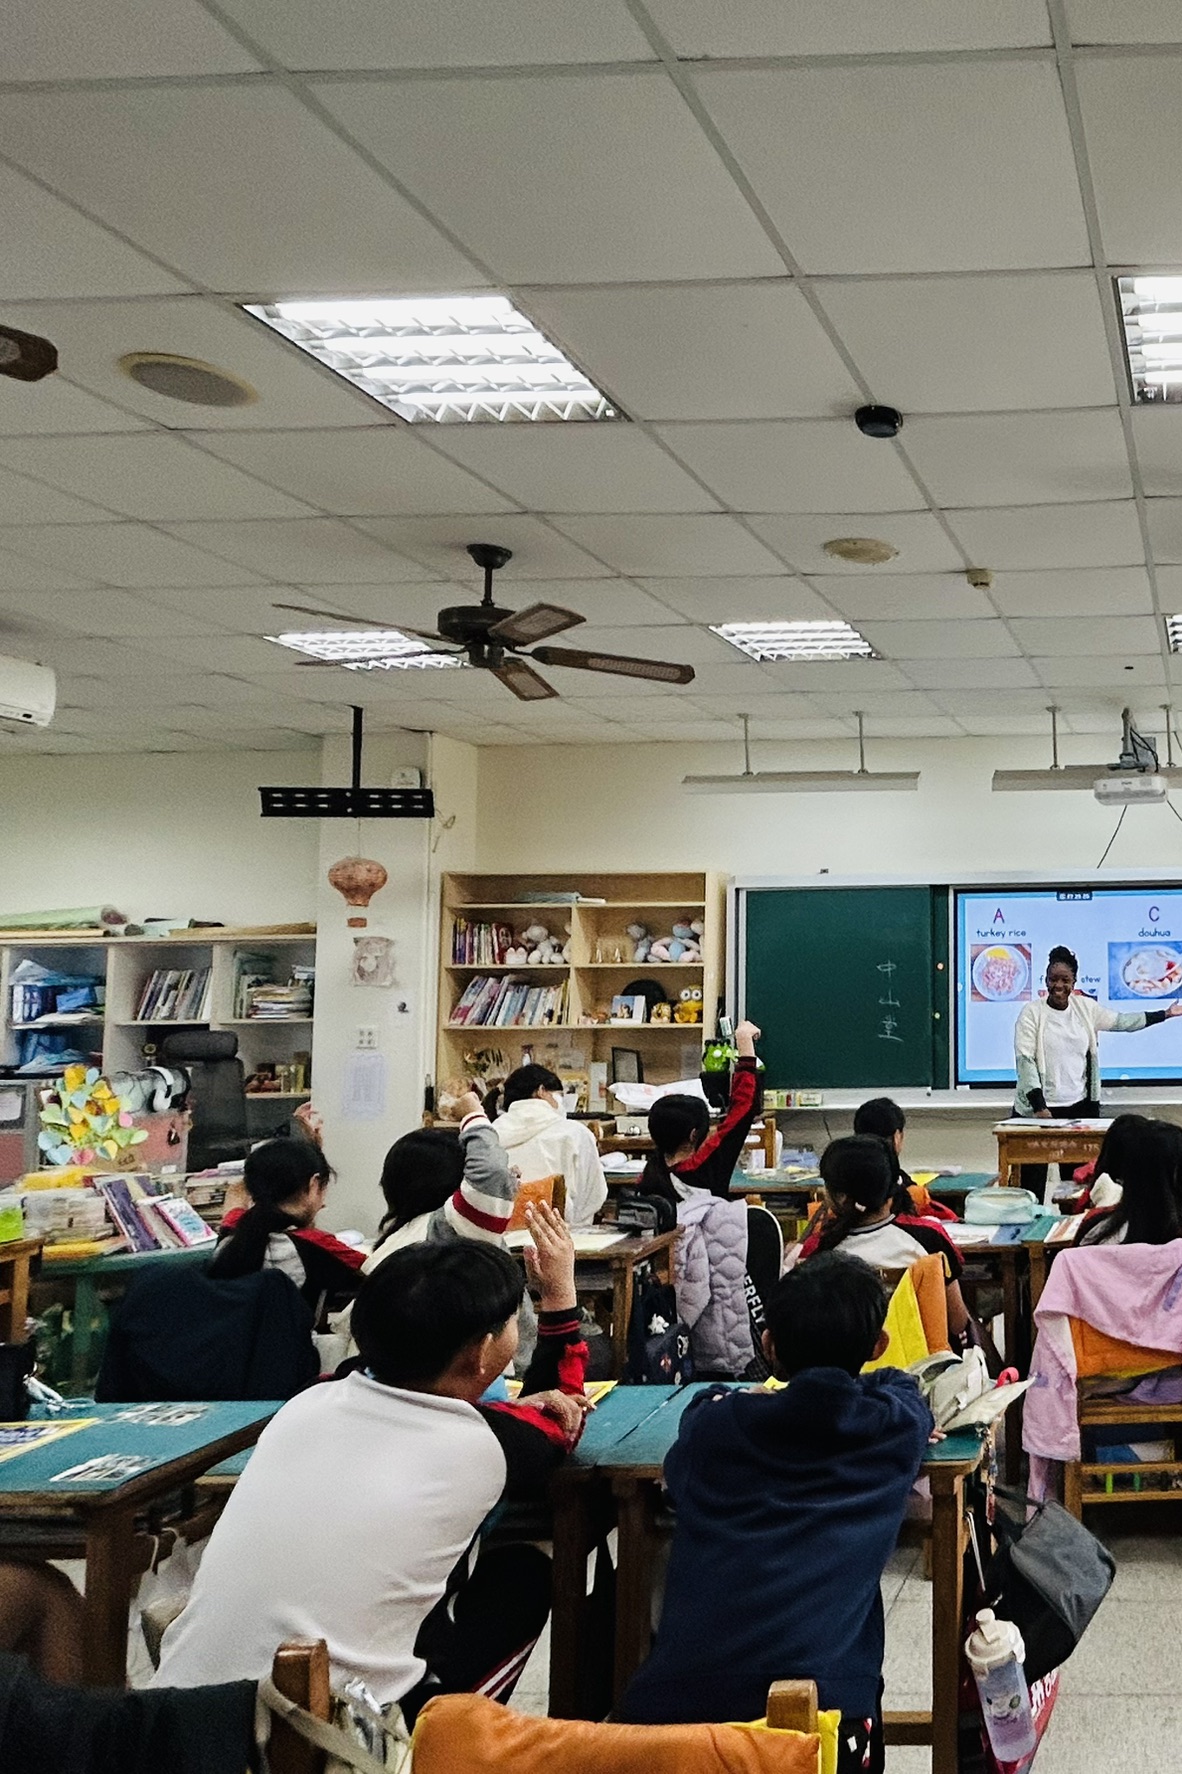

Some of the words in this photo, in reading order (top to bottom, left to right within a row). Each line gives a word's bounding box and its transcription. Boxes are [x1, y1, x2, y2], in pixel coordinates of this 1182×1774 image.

[993, 907, 1005, 924] A
[1149, 906, 1160, 922] C
[976, 929, 1005, 938] turkey
[1009, 929, 1026, 937] rice
[1138, 928, 1171, 937] douhua
